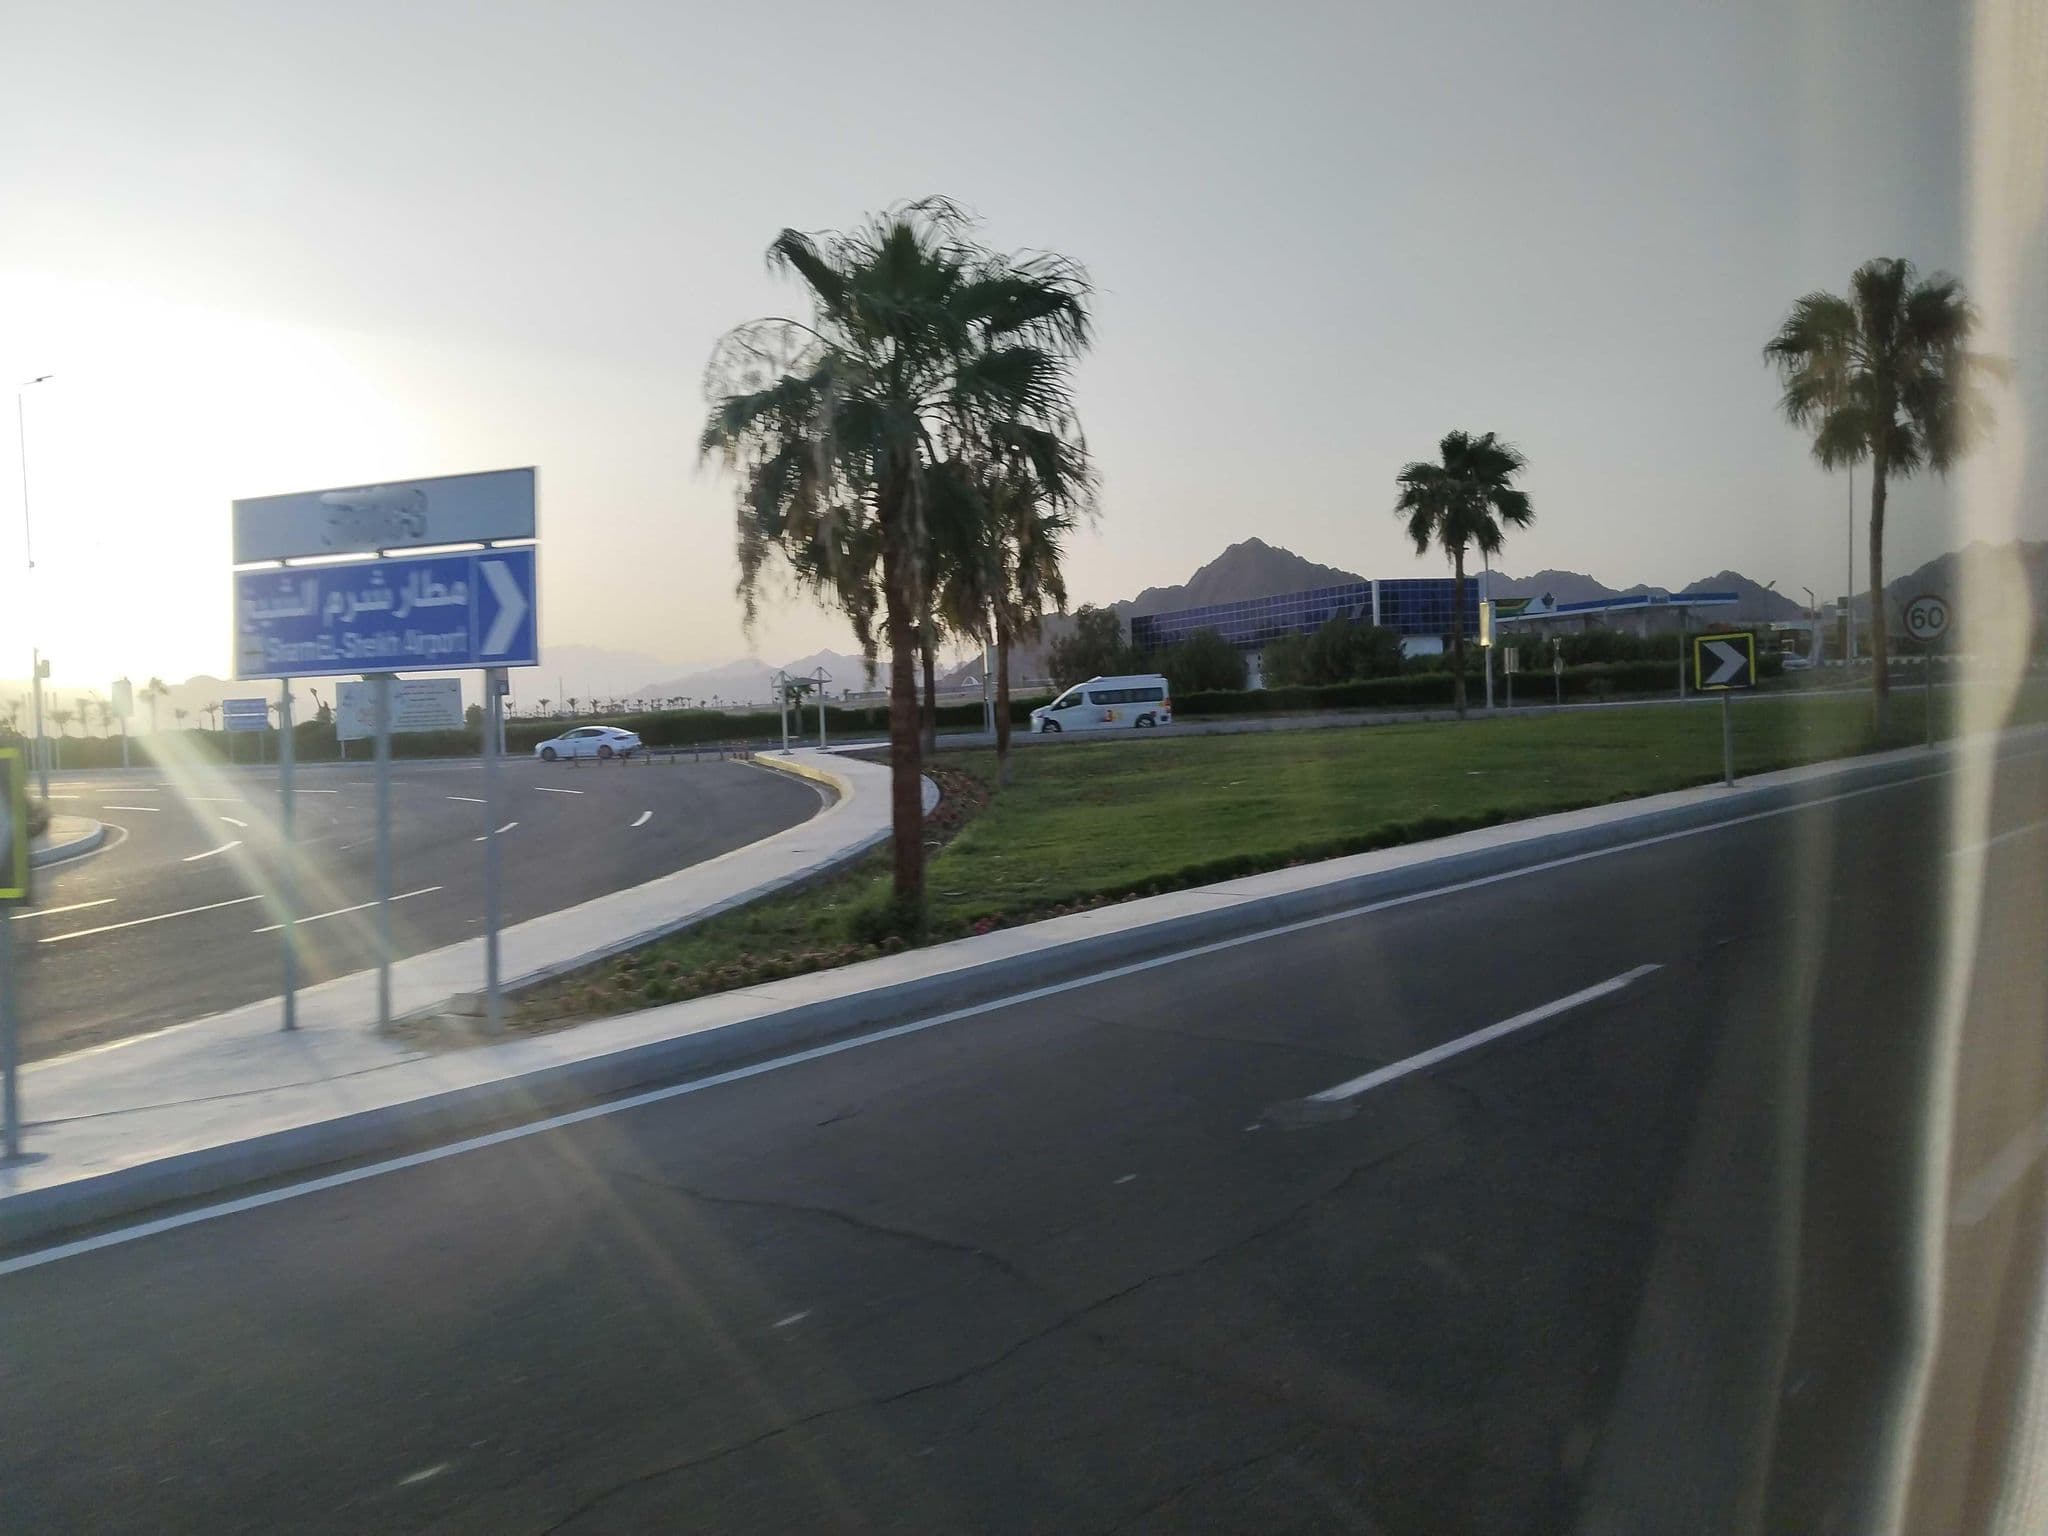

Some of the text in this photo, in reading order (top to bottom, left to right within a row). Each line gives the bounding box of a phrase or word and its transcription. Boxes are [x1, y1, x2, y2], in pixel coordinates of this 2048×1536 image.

[322, 569, 394, 628] شرم
[393, 569, 467, 618] مطار
[1911, 607, 1944, 630] 60
